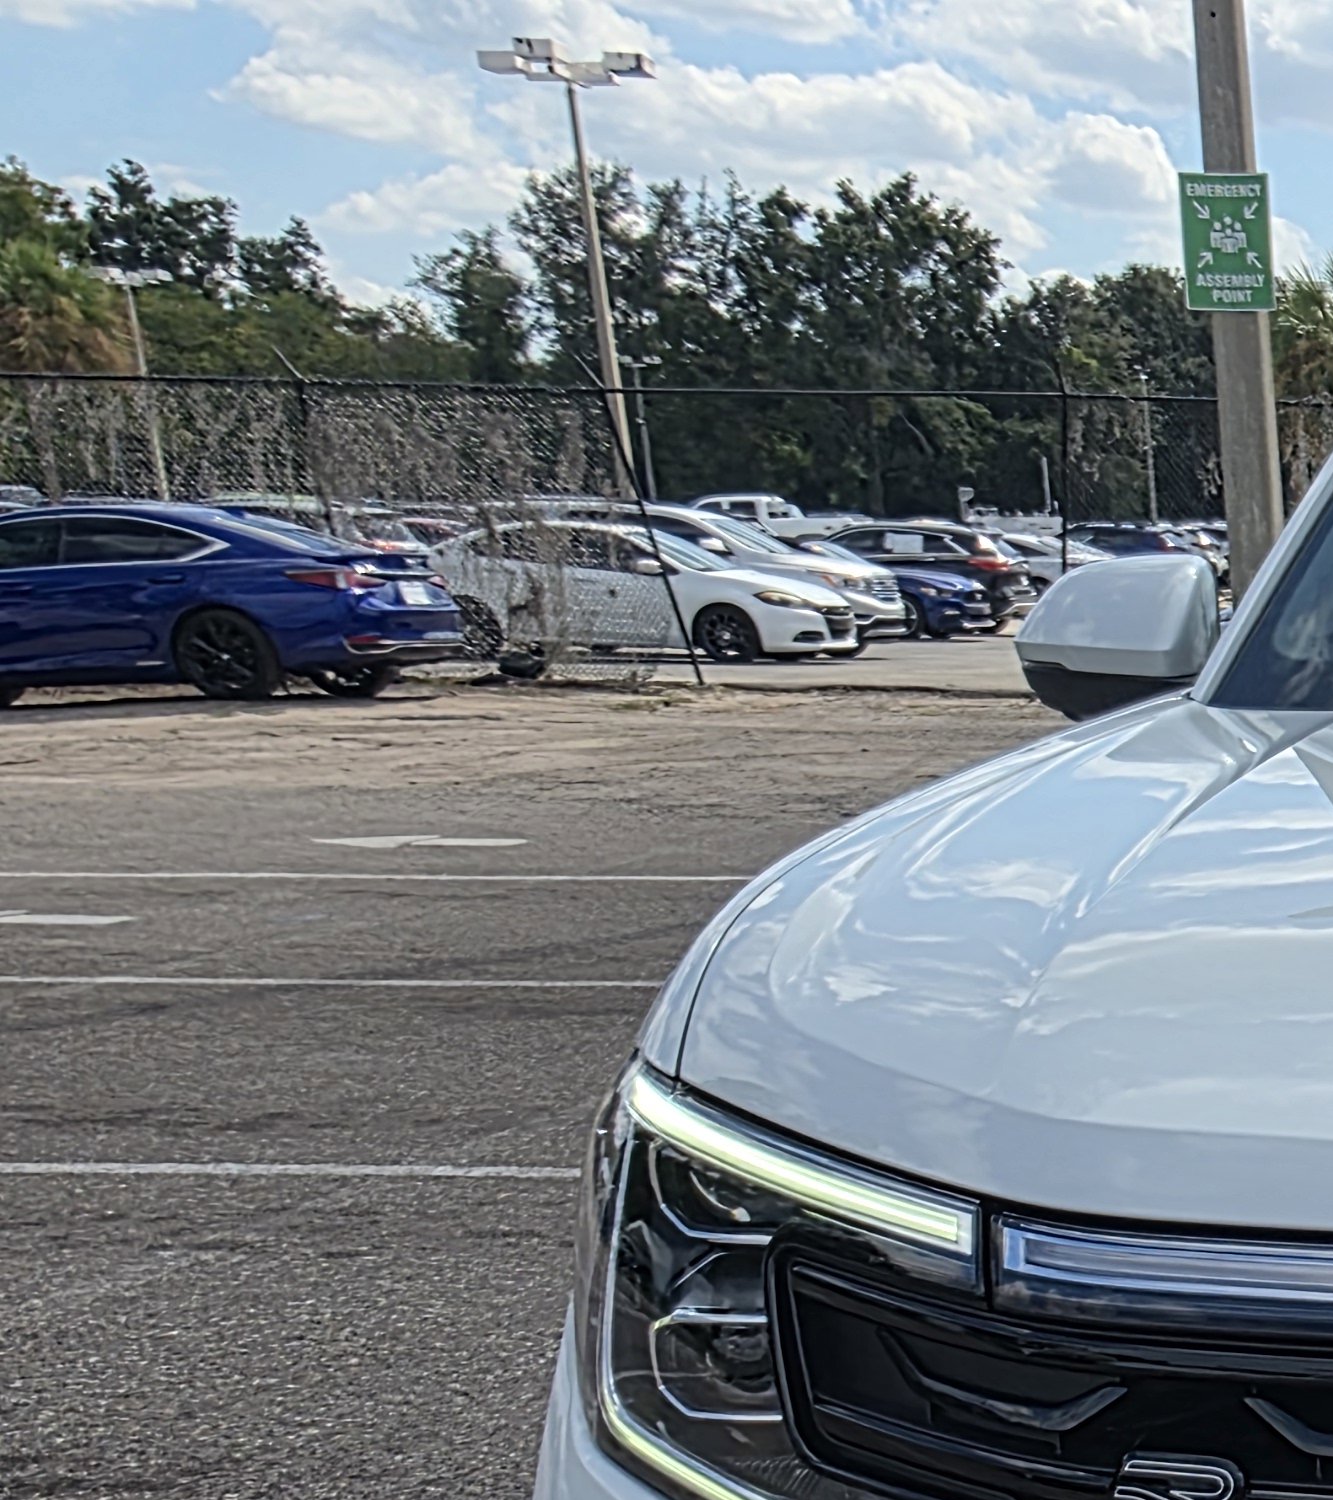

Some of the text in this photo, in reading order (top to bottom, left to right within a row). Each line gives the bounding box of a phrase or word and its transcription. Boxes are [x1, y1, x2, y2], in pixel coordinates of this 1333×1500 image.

[1186, 183, 1262, 197] EMERGENCY
[1196, 274, 1265, 288] ASSEMBLY
[1212, 290, 1253, 303] POINT
